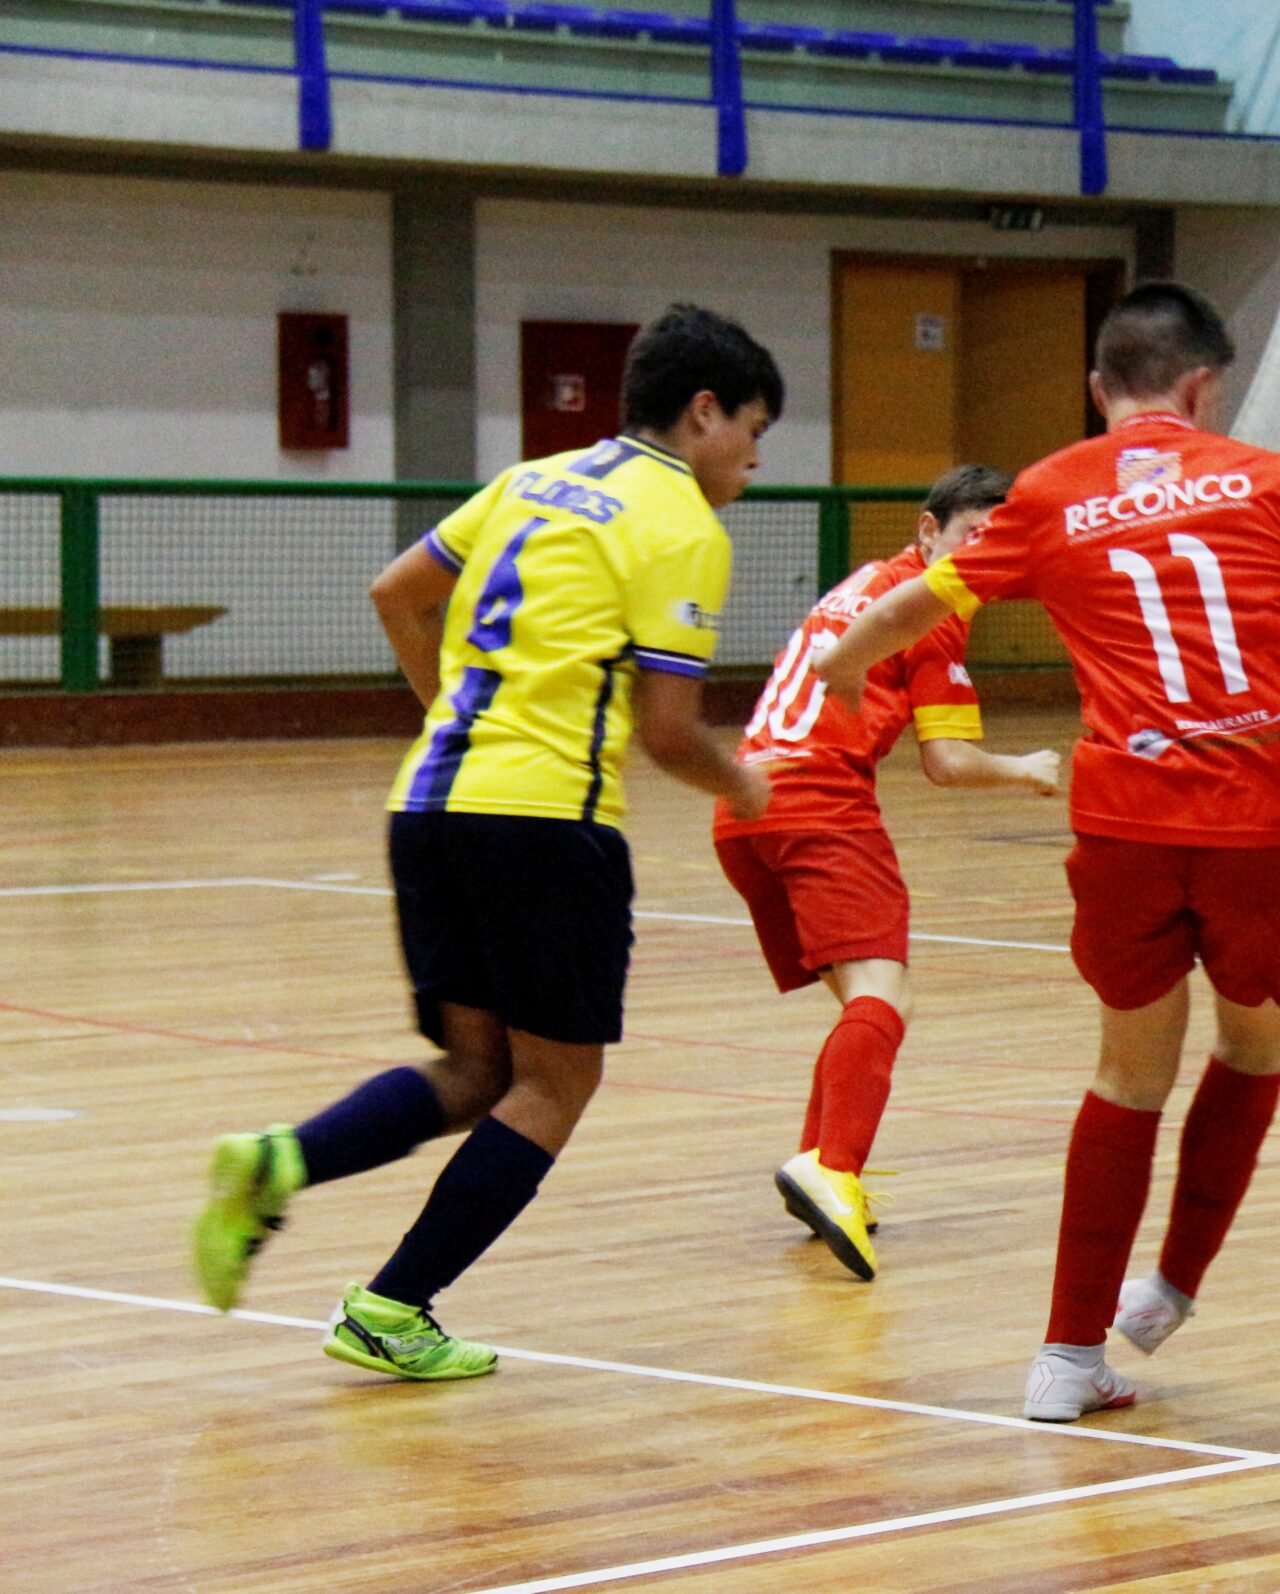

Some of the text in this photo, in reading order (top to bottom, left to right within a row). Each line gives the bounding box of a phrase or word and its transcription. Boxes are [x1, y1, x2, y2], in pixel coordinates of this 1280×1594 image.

[1064, 474, 1252, 537] RECONCO
[1107, 532, 1251, 704] 11
[744, 628, 840, 742] 10
